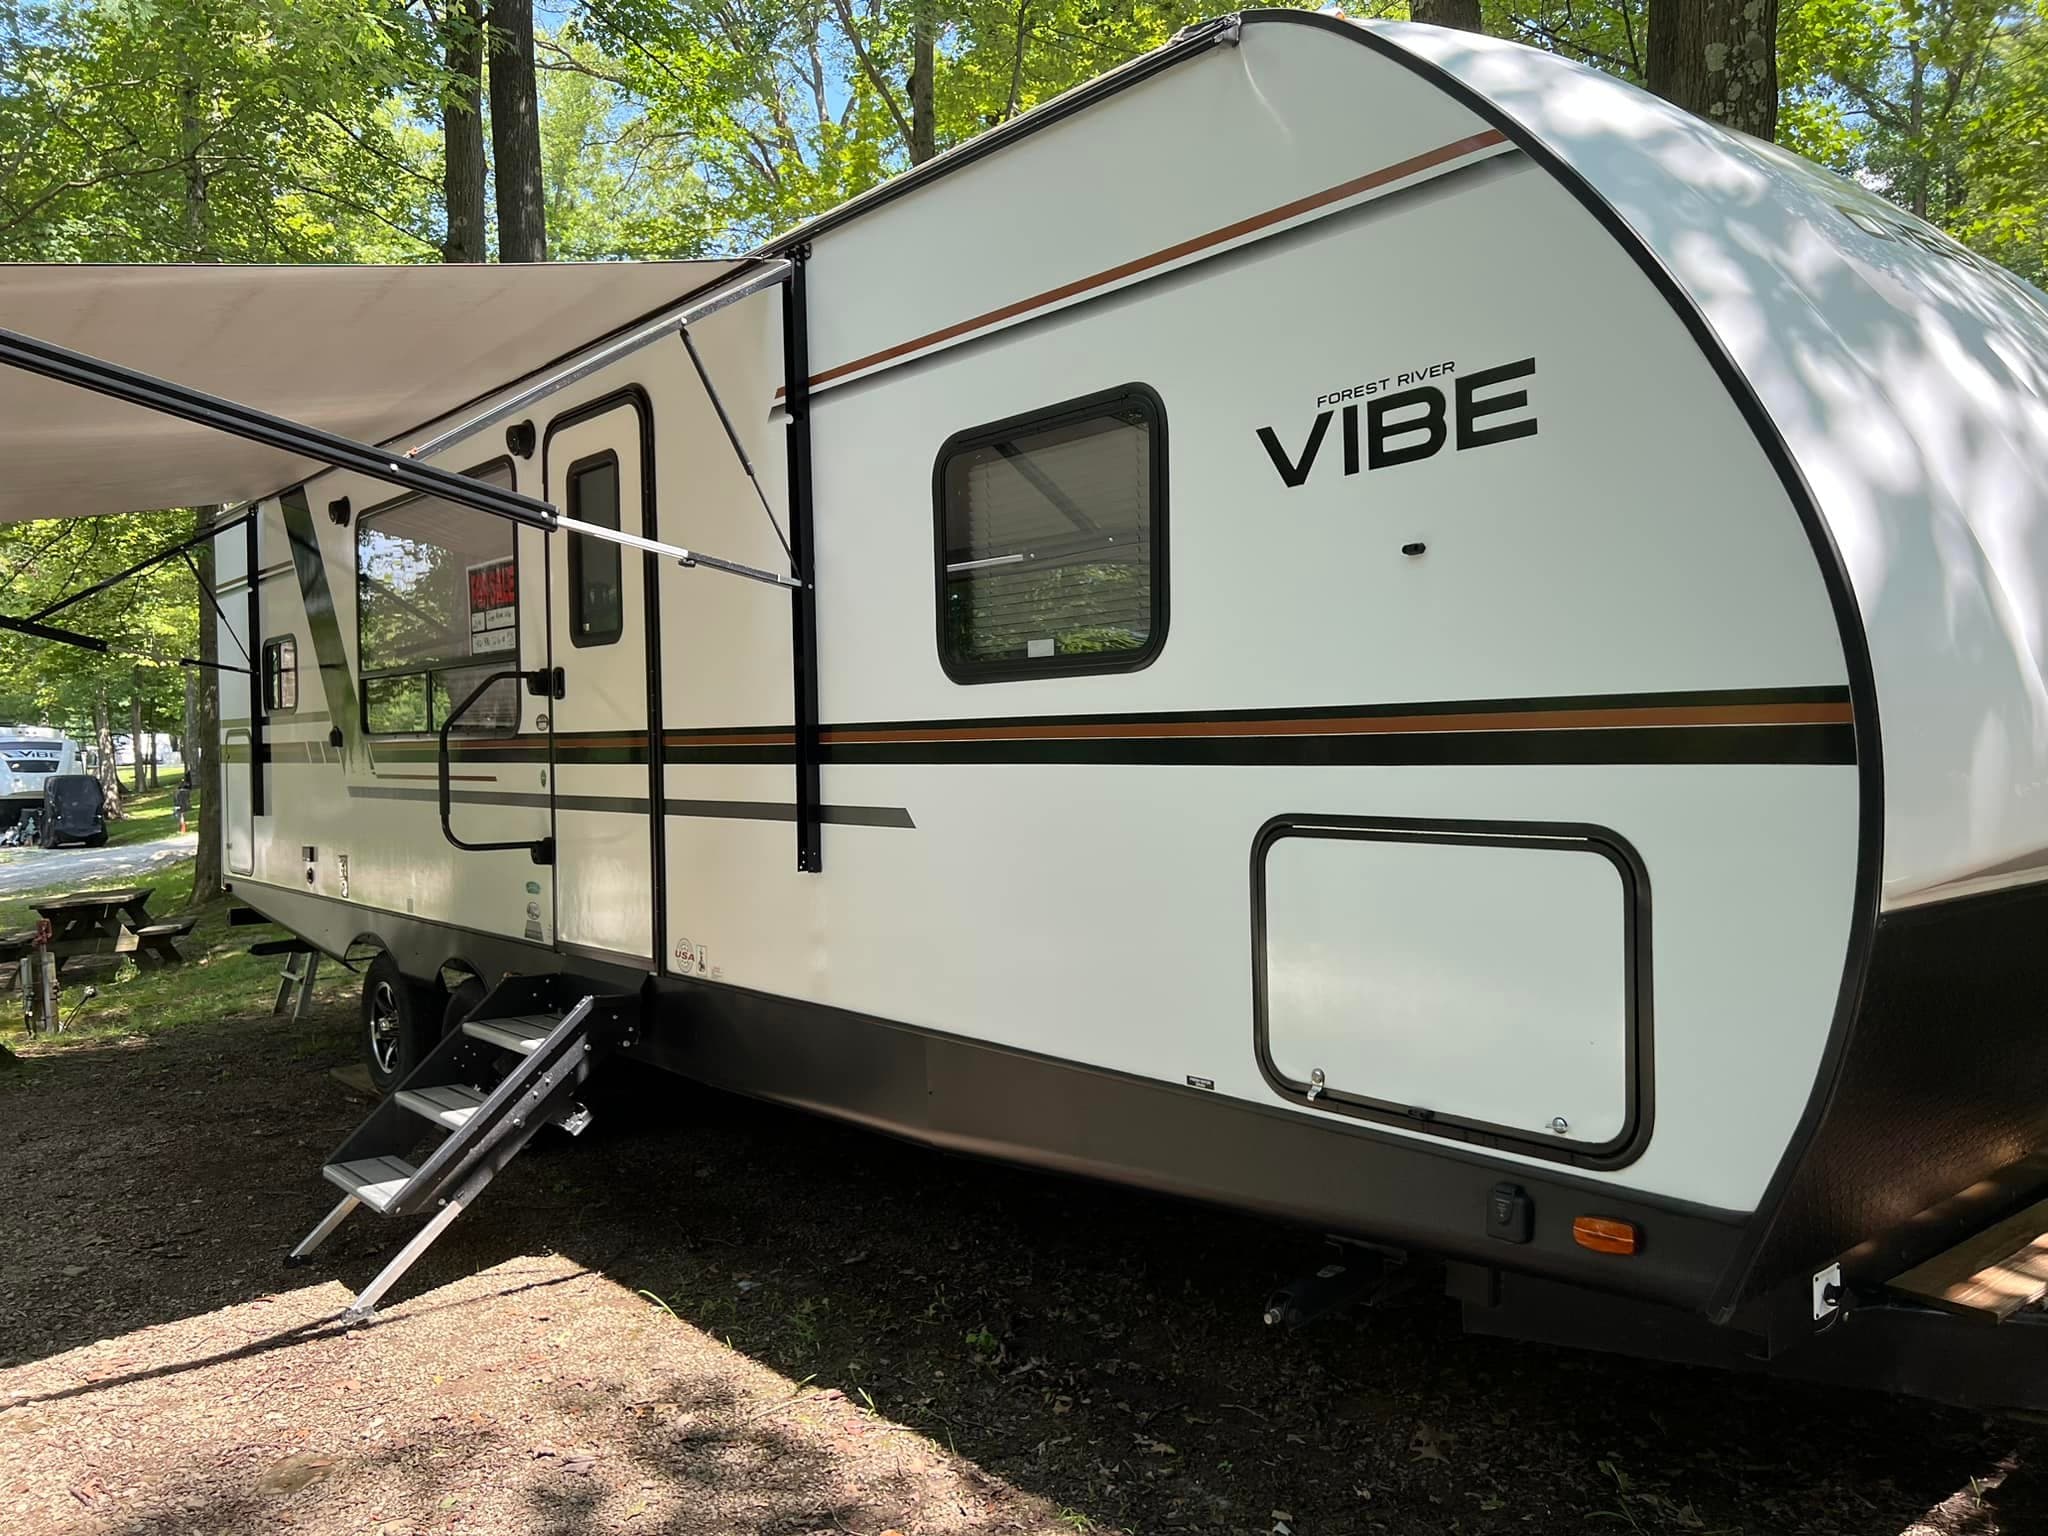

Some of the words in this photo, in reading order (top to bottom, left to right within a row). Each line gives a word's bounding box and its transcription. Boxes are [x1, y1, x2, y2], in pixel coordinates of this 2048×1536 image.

[1317, 378, 1390, 408] FOREST
[1397, 360, 1456, 387] RIVER
[1255, 356, 1538, 488] VIBE
[675, 950, 695, 961] USA
